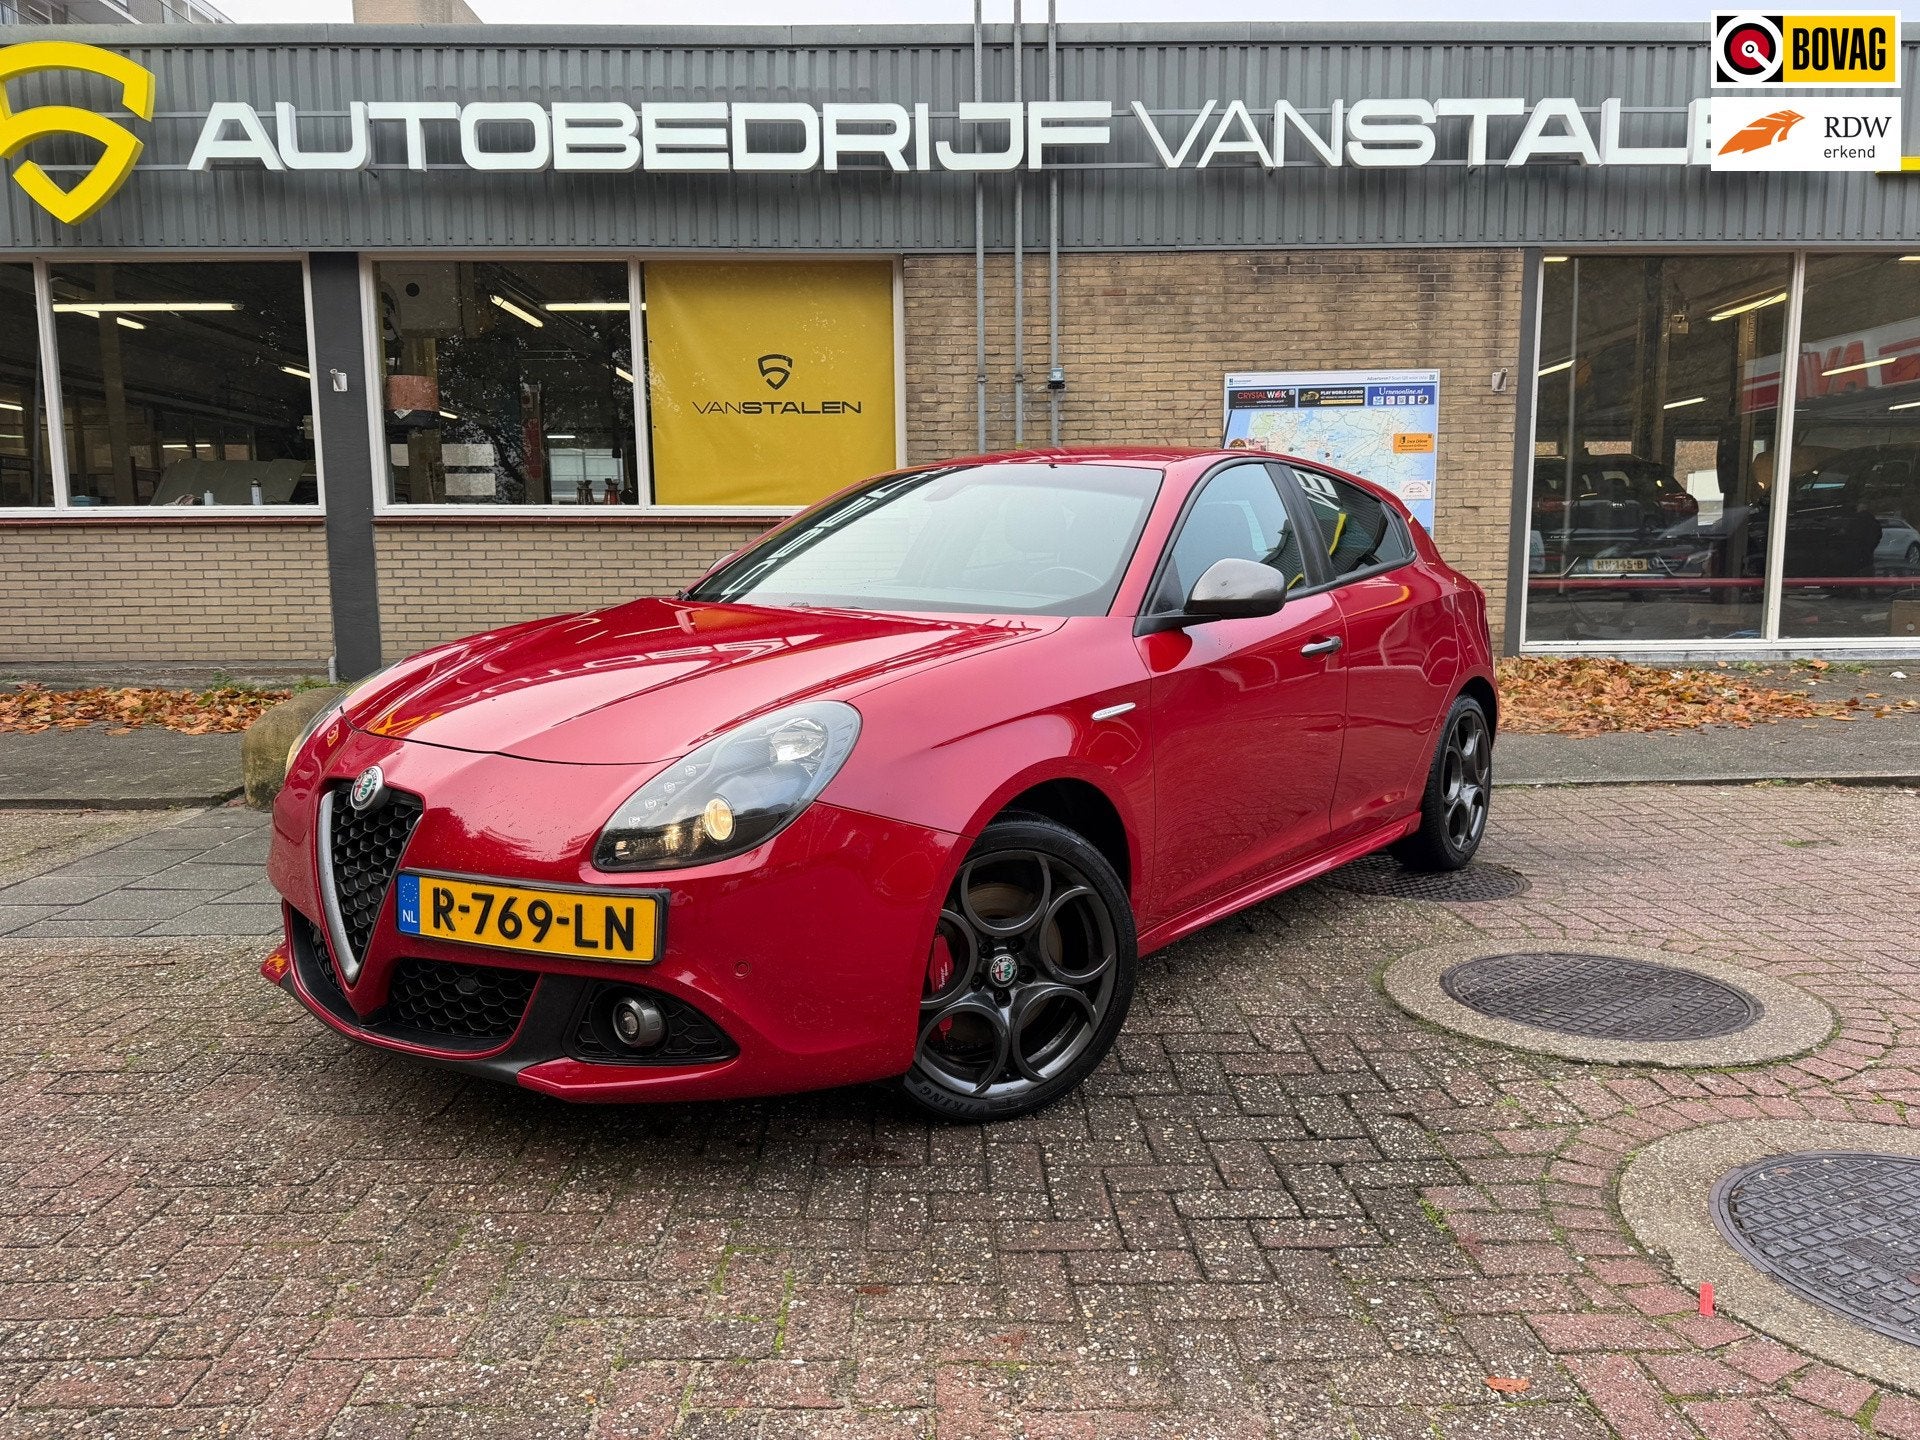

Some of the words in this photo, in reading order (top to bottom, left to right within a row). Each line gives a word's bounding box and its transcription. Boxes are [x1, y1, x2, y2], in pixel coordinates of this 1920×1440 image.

[187, 101, 1112, 173] AUTOBEDRIJF
[1131, 98, 1711, 169] VANSTAL
[692, 401, 862, 415] VANSTALEN
[1237, 392, 1266, 400] CRYSTAL
[402, 908, 418, 924] NL
[432, 887, 634, 951] R-769-LN
[919, 1085, 990, 1117] VIKING
